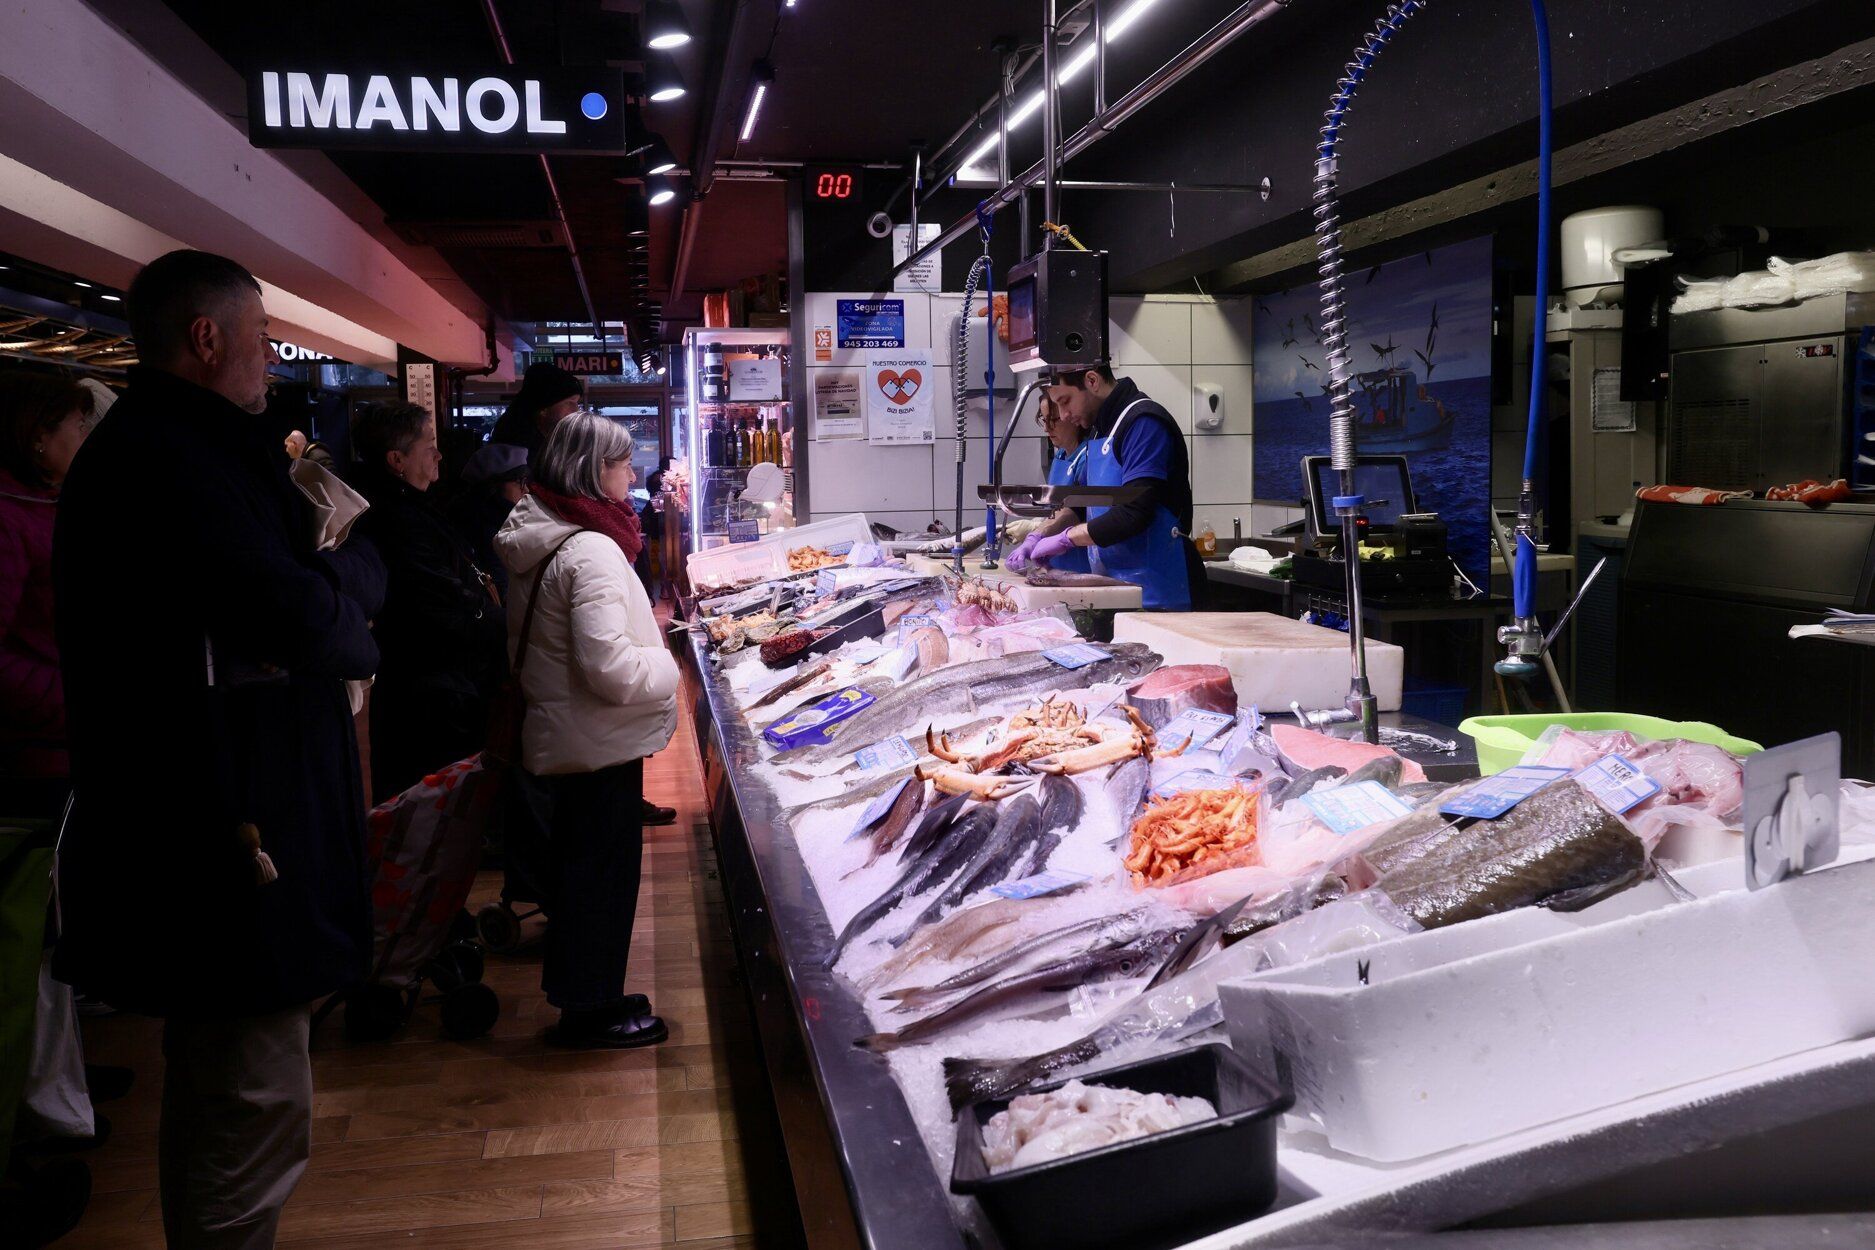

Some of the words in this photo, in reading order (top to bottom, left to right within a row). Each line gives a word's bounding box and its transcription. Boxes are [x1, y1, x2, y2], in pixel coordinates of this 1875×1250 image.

[262, 71, 566, 134] IMANOL
[817, 173, 852, 198] 00
[854, 303, 899, 313] Seguricom
[844, 340, 861, 348] 945
[863, 340, 880, 348] 203
[881, 340, 899, 348] 469
[557, 356, 607, 371] MARI
